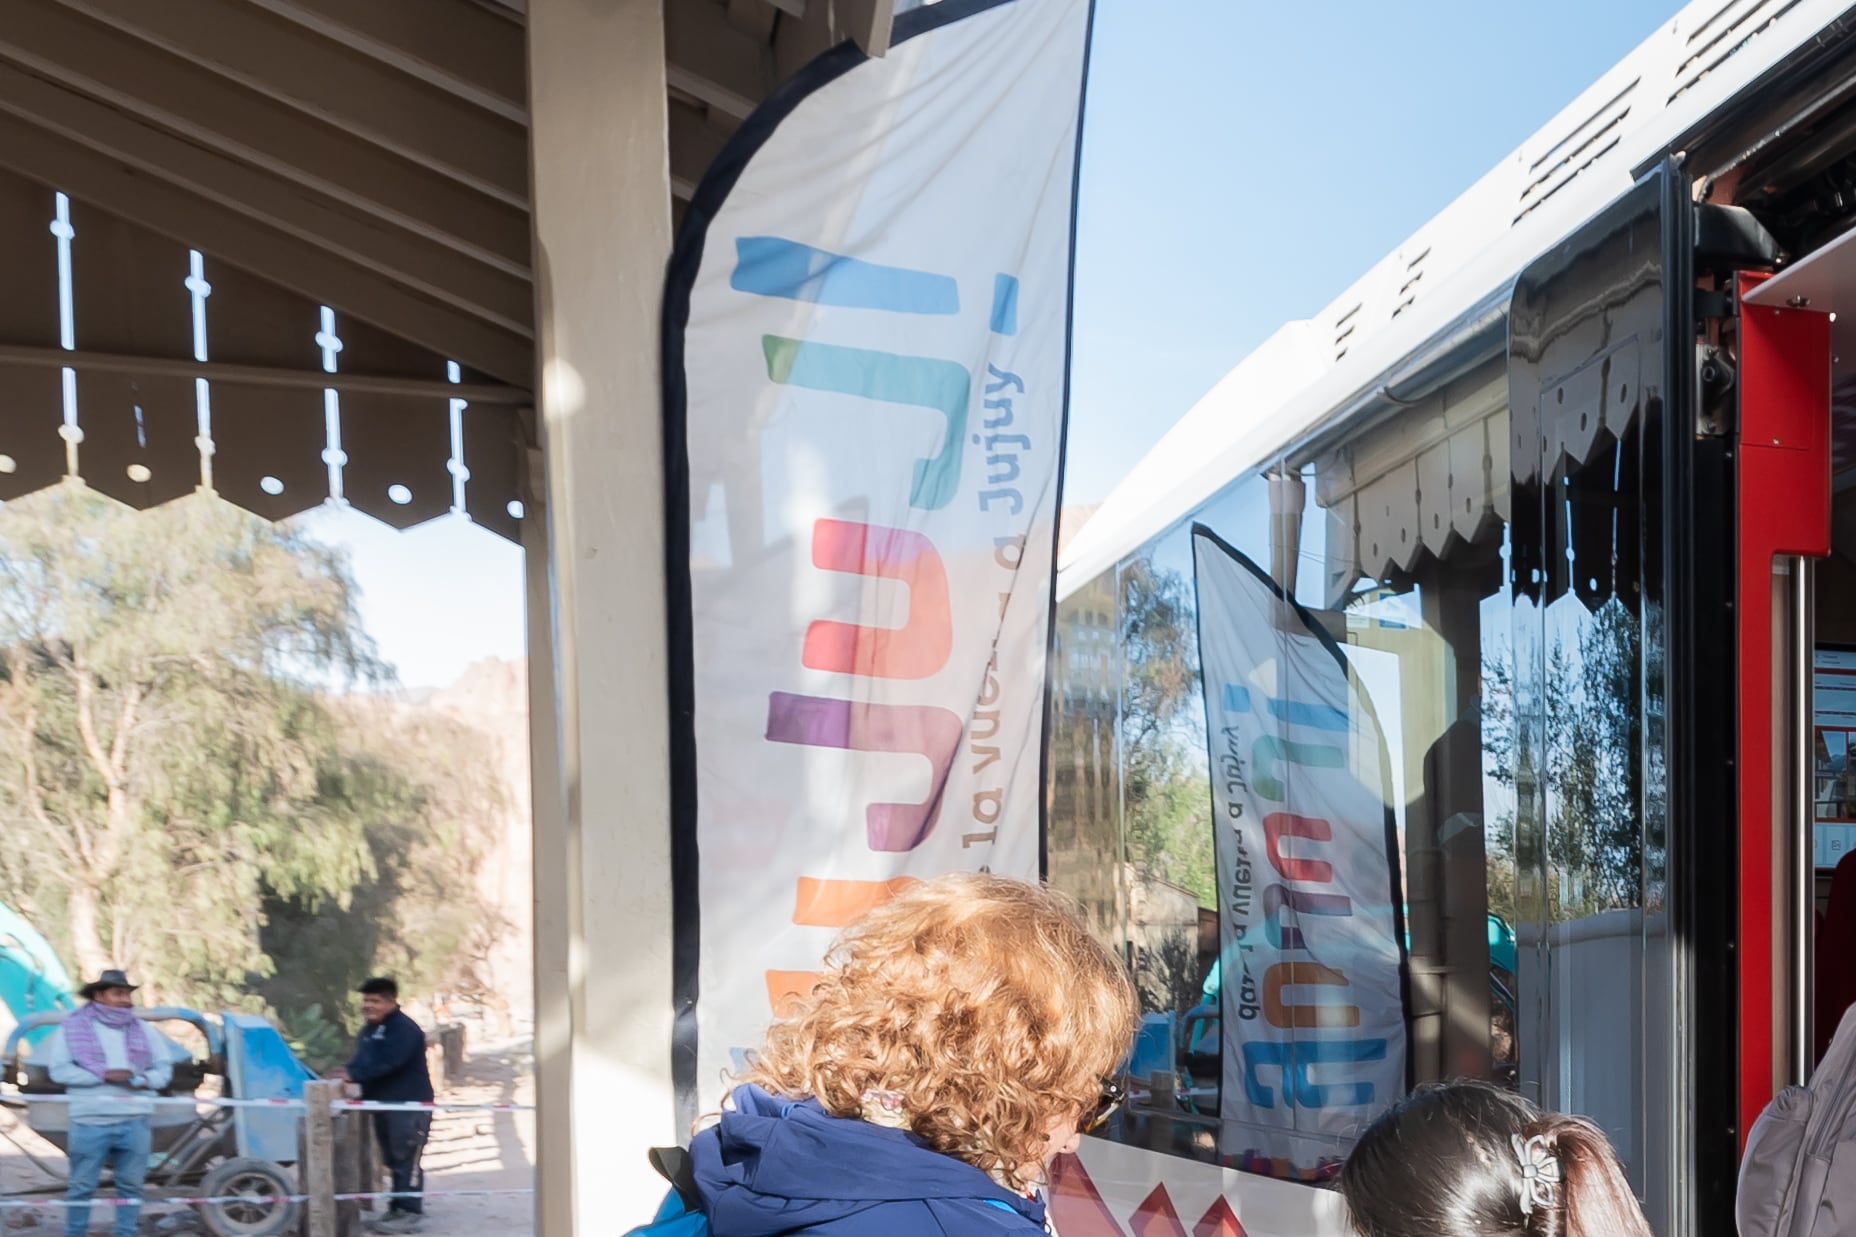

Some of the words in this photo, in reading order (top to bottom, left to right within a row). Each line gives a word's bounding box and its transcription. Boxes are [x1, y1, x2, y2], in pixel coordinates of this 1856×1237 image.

[972, 362, 1031, 515] Jujuy
[989, 535, 1027, 570] a
[962, 788, 1004, 849] la
